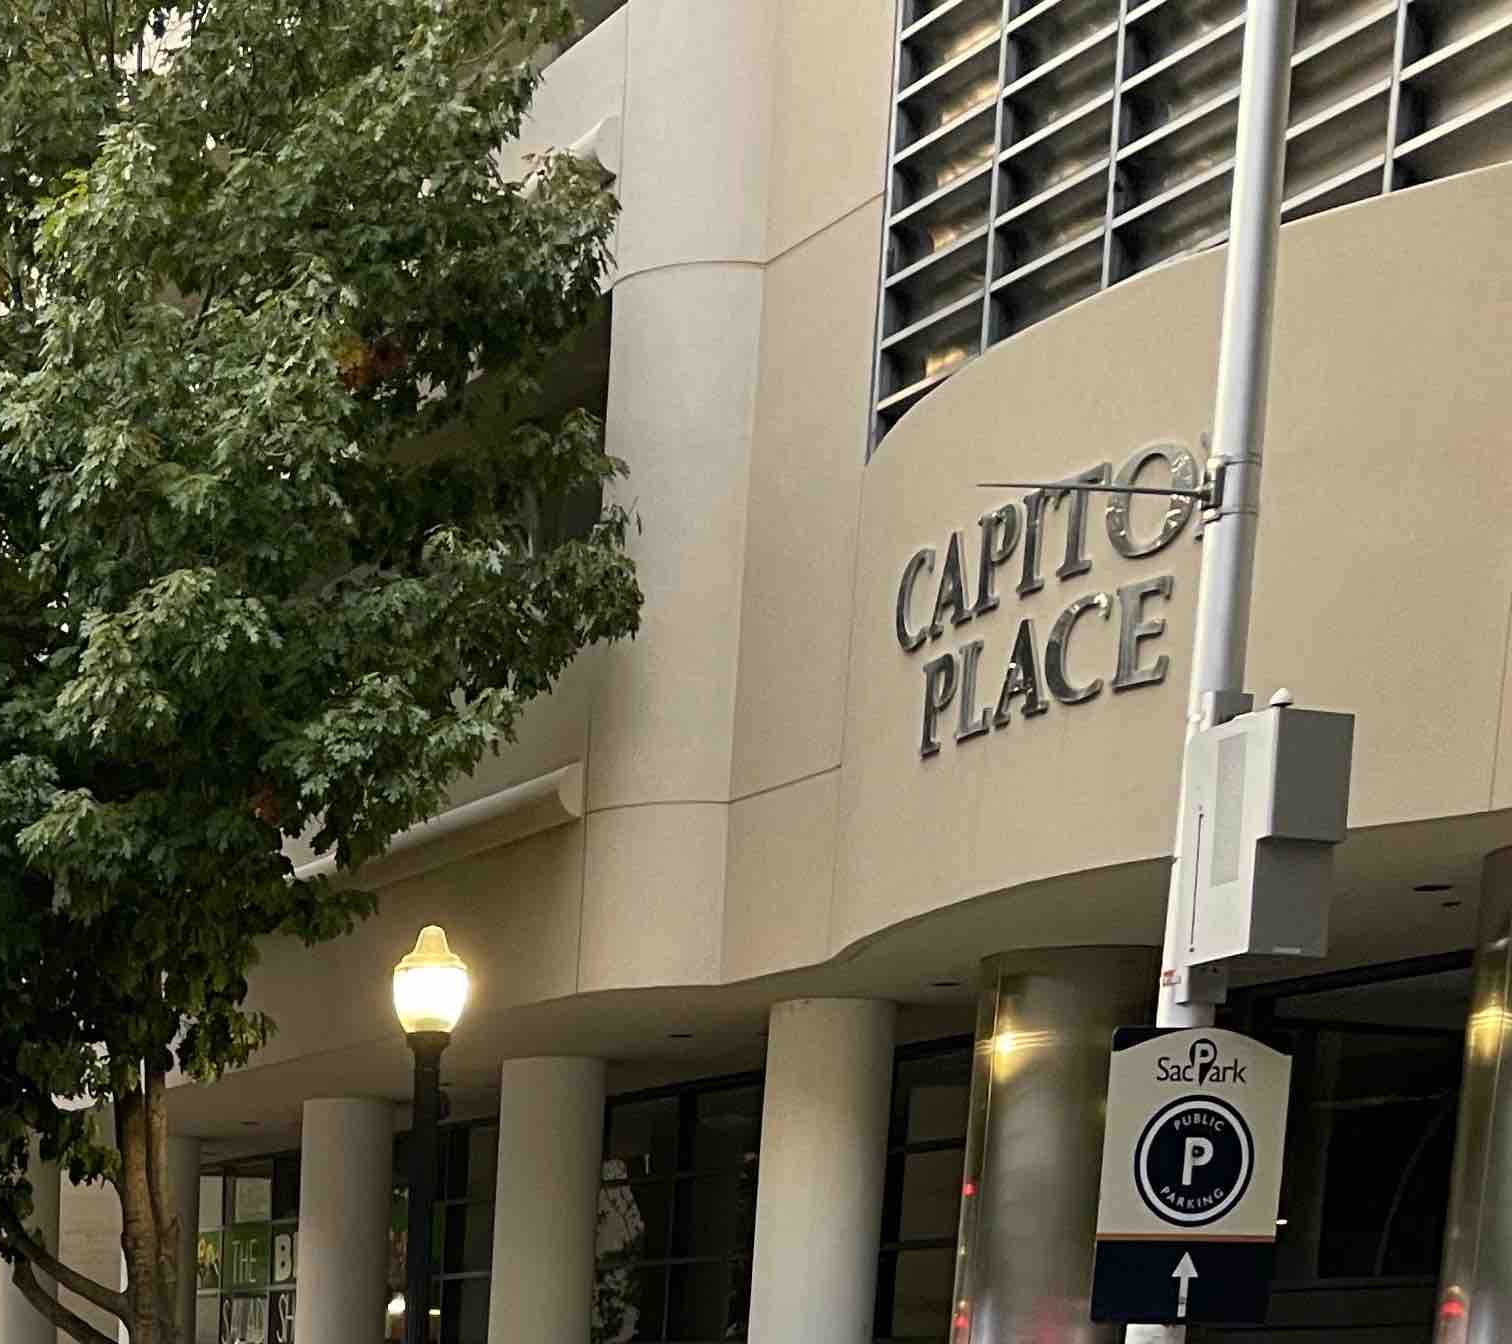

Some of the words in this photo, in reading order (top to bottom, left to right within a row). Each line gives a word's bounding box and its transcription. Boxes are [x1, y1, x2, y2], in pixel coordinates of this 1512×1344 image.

[895, 436, 1209, 653] CAPITO
[920, 574, 1175, 759] PLACE
[1173, 1112, 1225, 1132] PUBLIC
[1181, 1137, 1214, 1186] P
[1160, 1185, 1225, 1210] PARKING
